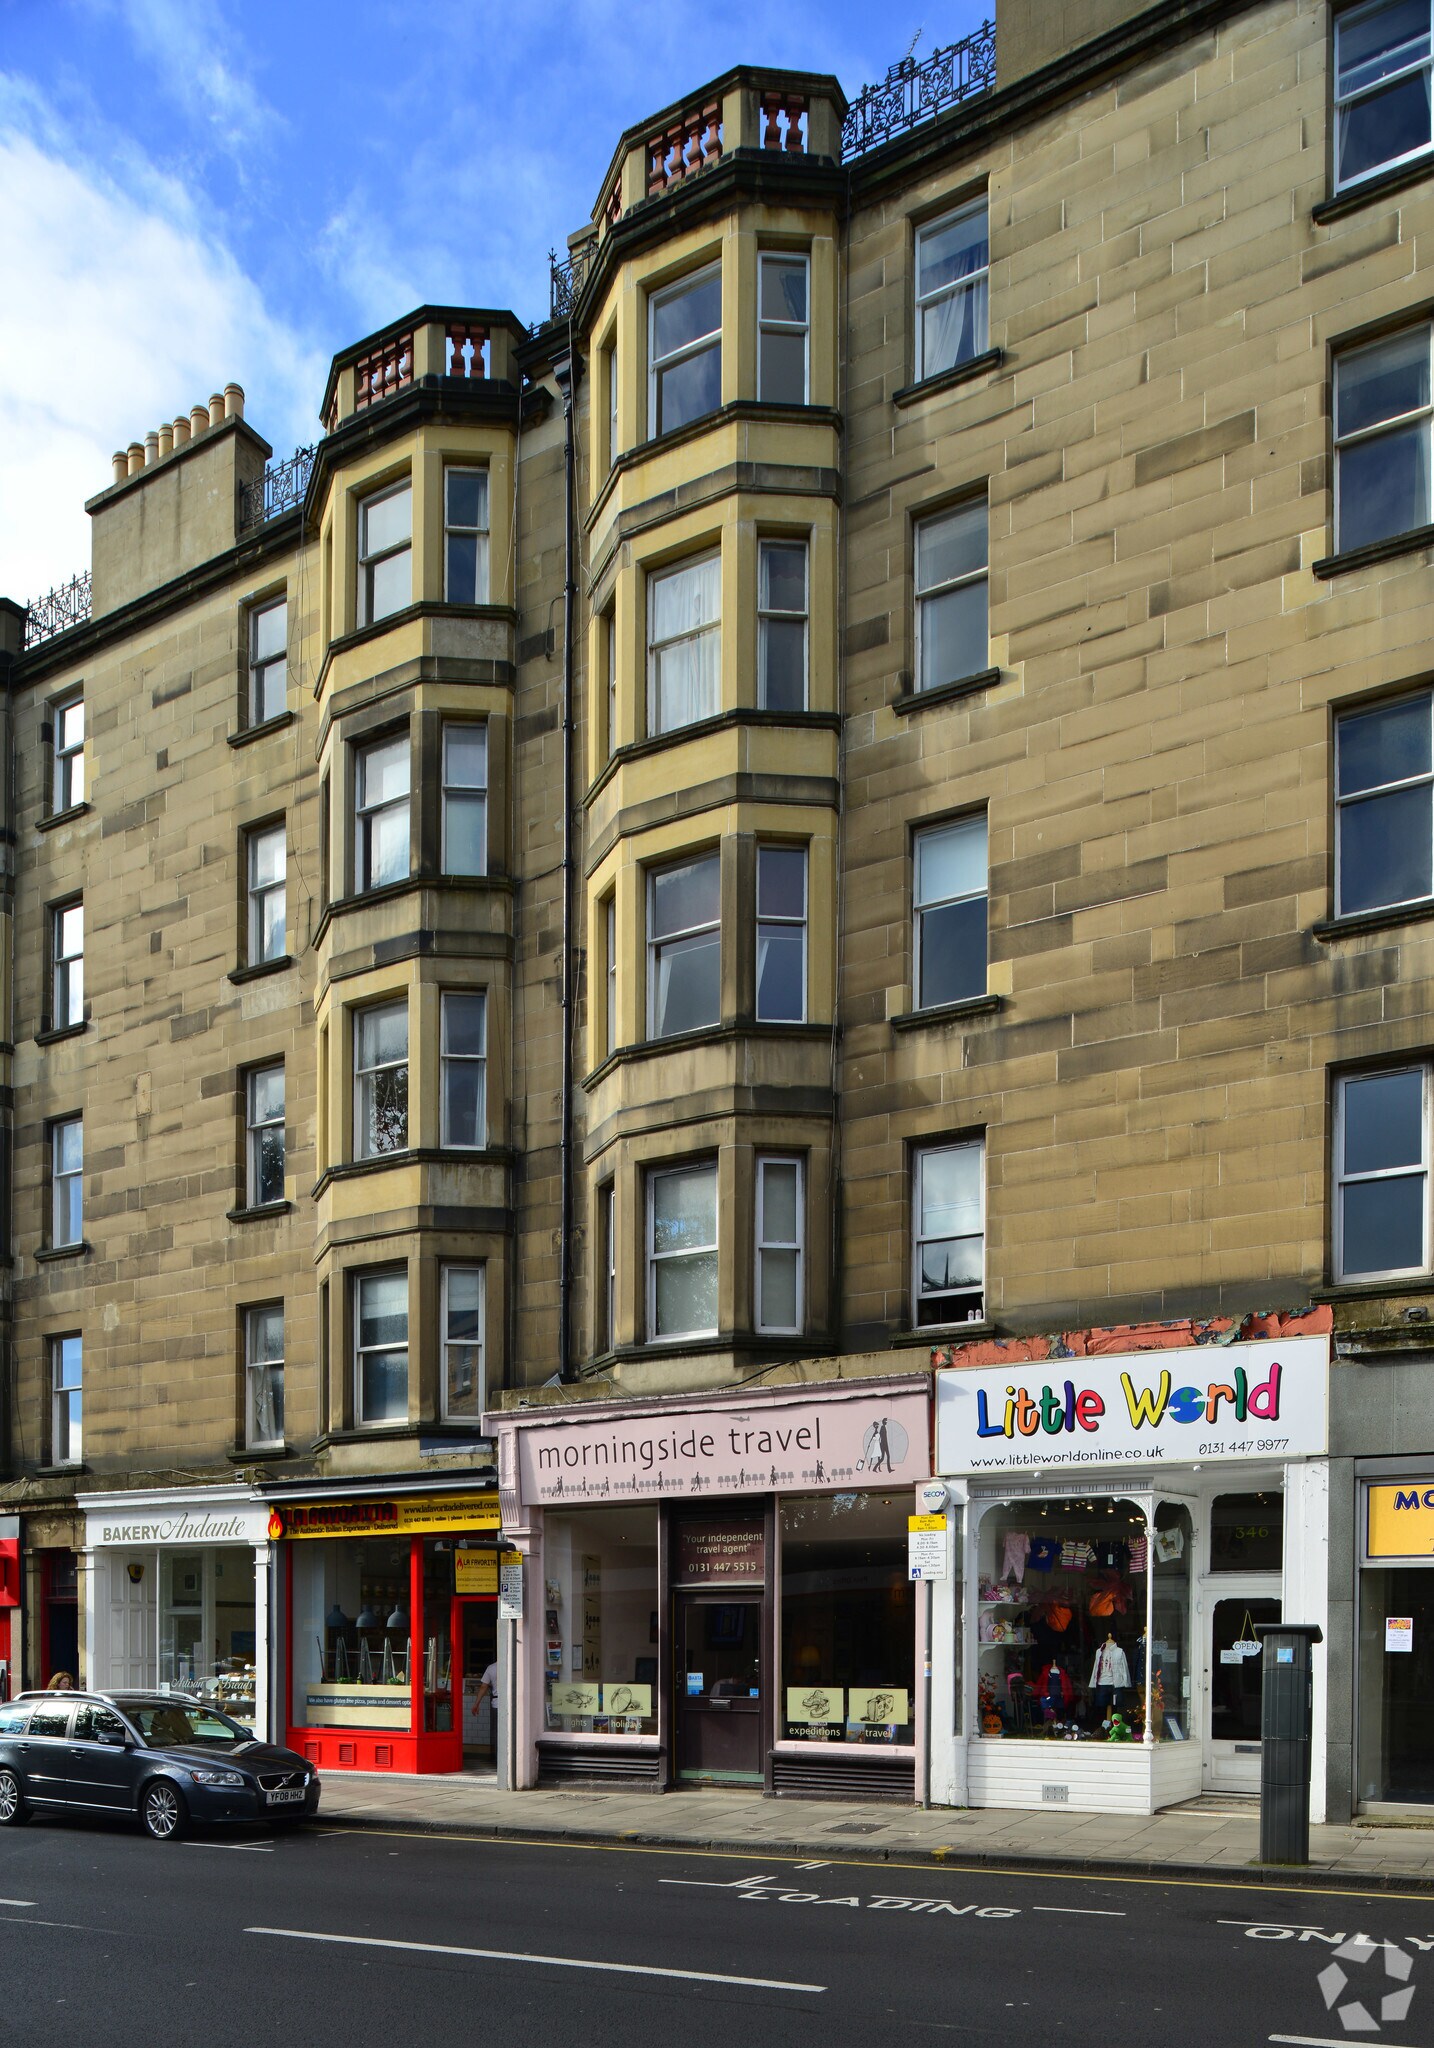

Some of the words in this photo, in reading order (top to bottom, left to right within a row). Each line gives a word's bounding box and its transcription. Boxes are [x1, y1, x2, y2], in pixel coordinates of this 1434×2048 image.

[976, 1380, 1105, 1438] Little
[1119, 1362, 1283, 1430] World
[538, 1429, 714, 1470] morningside
[728, 1417, 821, 1455] travel
[1199, 1442, 1225, 1455] 0131
[1229, 1441, 1254, 1452] 447
[1257, 1439, 1289, 1451] 9977
[970, 1446, 1165, 1467] www.littleworldonline.co.uk
[923, 1490, 945, 1498] SECOM
[403, 1501, 499, 1514] www.lafavoritadelivered.com
[103, 1525, 160, 1541] BAKERY
[160, 1512, 246, 1540] Andante
[300, 1525, 325, 1534] Authentic
[325, 1524, 342, 1533] Italian
[343, 1522, 370, 1532] Experience
[374, 1521, 398, 1530] Delivered
[1235, 1526, 1269, 1539] 346
[683, 1534, 705, 1543] "Your
[708, 1532, 763, 1543] independent
[696, 1544, 720, 1554] travel
[723, 1543, 751, 1554] agent"
[471, 1558, 497, 1566] FAVORITA
[689, 1563, 710, 1572] 0131
[713, 1562, 731, 1572] 447
[734, 1562, 756, 1571] 5515
[1234, 1642, 1258, 1650] OPEN
[171, 1676, 204, 1688] Artisan
[220, 1679, 252, 1689] Breads
[611, 1719, 642, 1729] holidays
[789, 1726, 840, 1737] expeditions
[865, 1729, 893, 1738] travel
[271, 1792, 289, 1801] YF08
[290, 1791, 303, 1800] HHZ
[738, 1890, 1021, 1918] LOADING
[1244, 1927, 1434, 1950] ONLY
